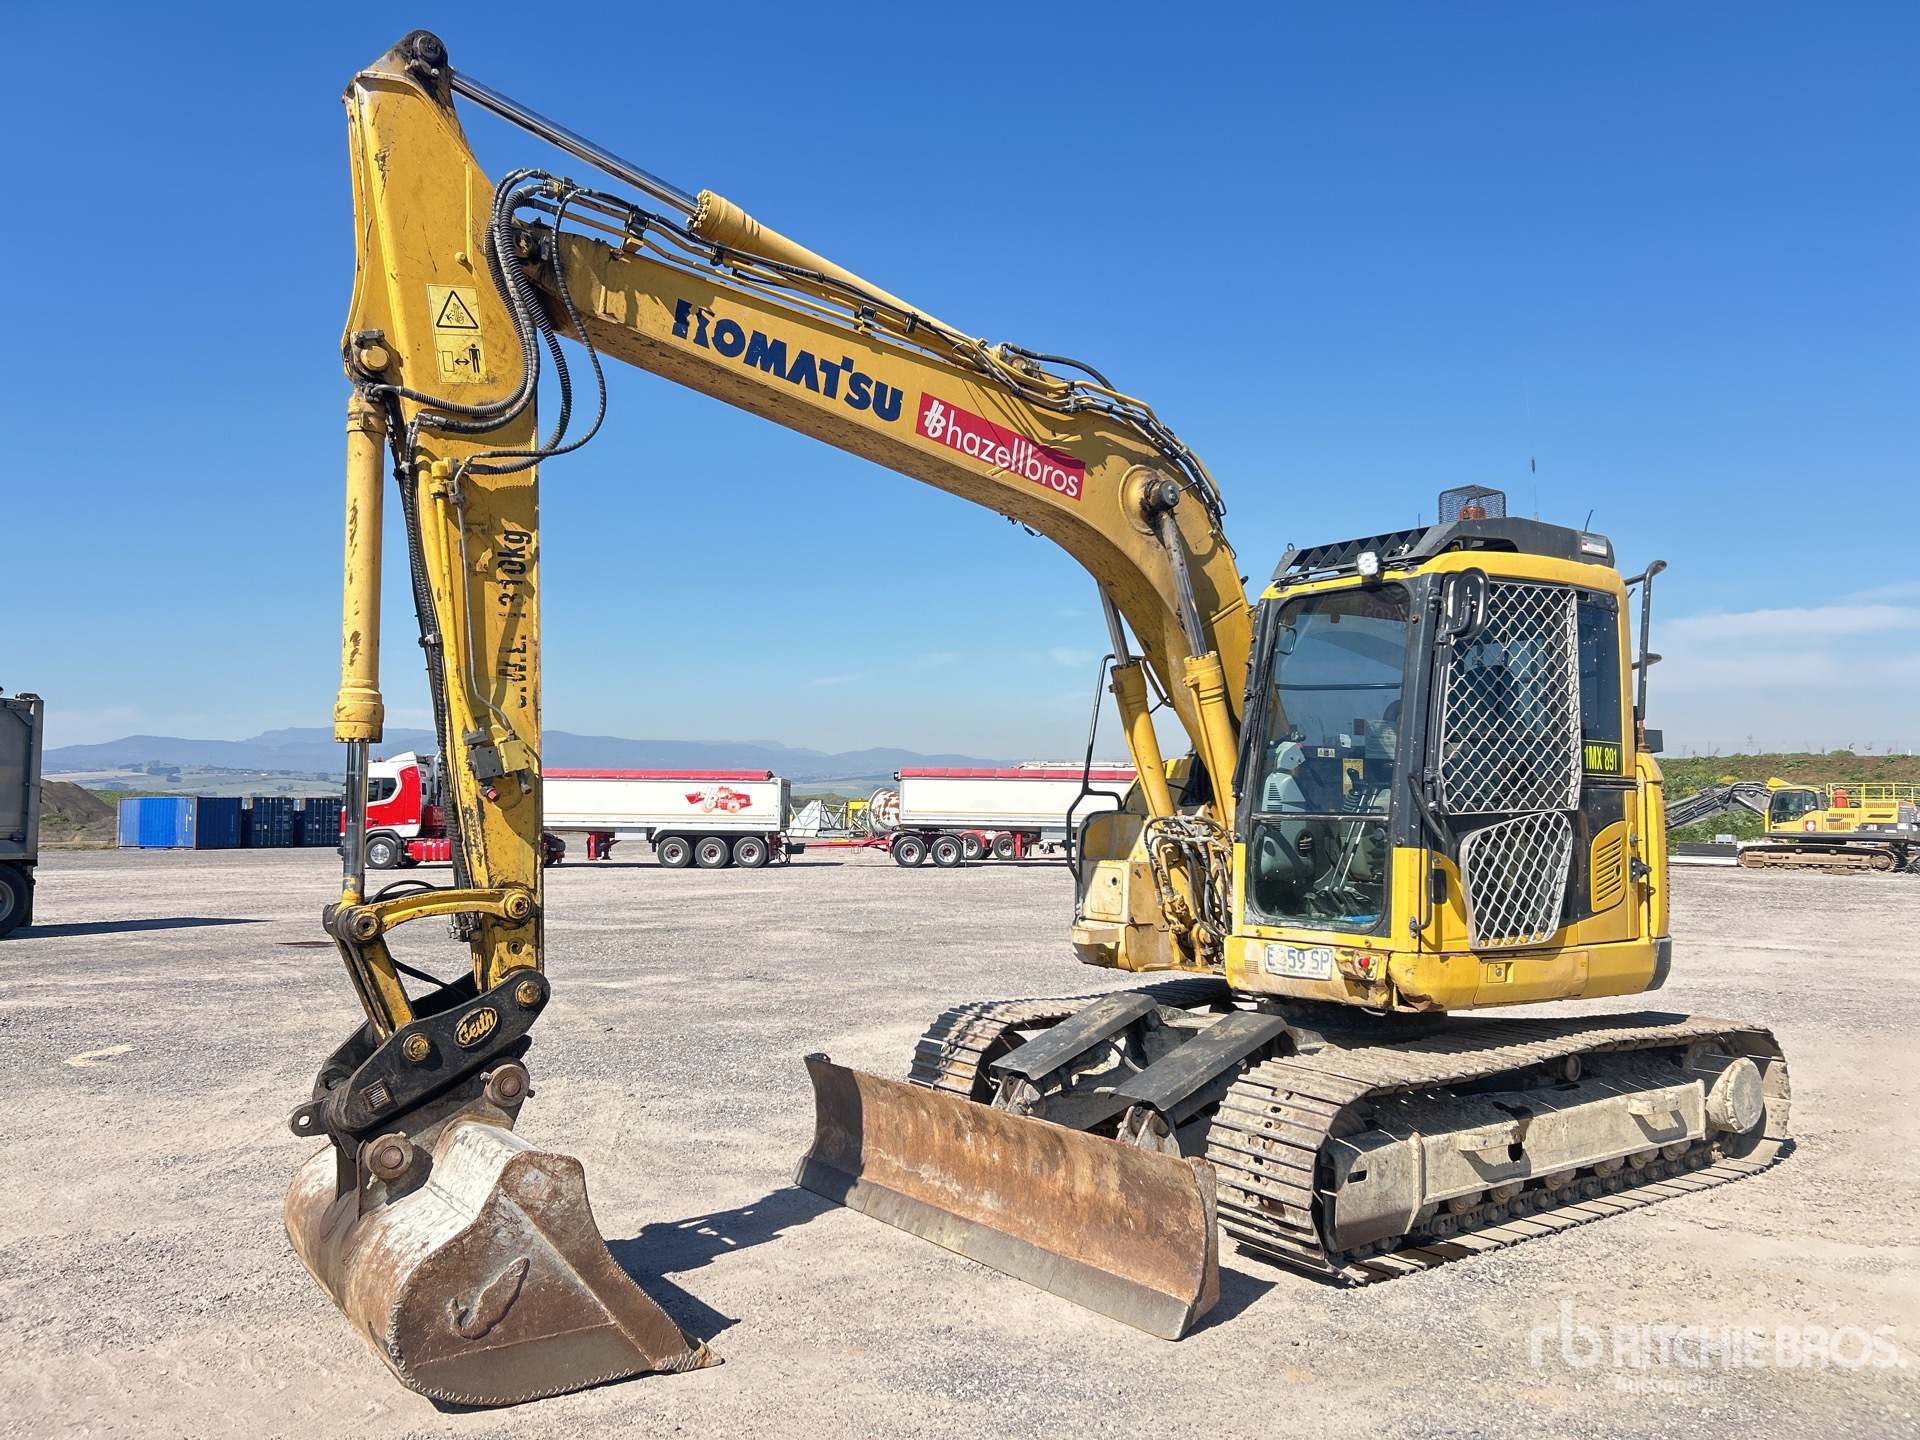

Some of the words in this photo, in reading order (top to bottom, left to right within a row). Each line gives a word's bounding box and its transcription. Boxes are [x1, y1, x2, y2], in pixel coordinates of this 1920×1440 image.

[672, 298, 904, 422] KOMATSU
[1604, 747, 1618, 771] 891
[1267, 946, 1275, 967] E
[1287, 949, 1306, 970] 59
[1311, 950, 1330, 971] SP
